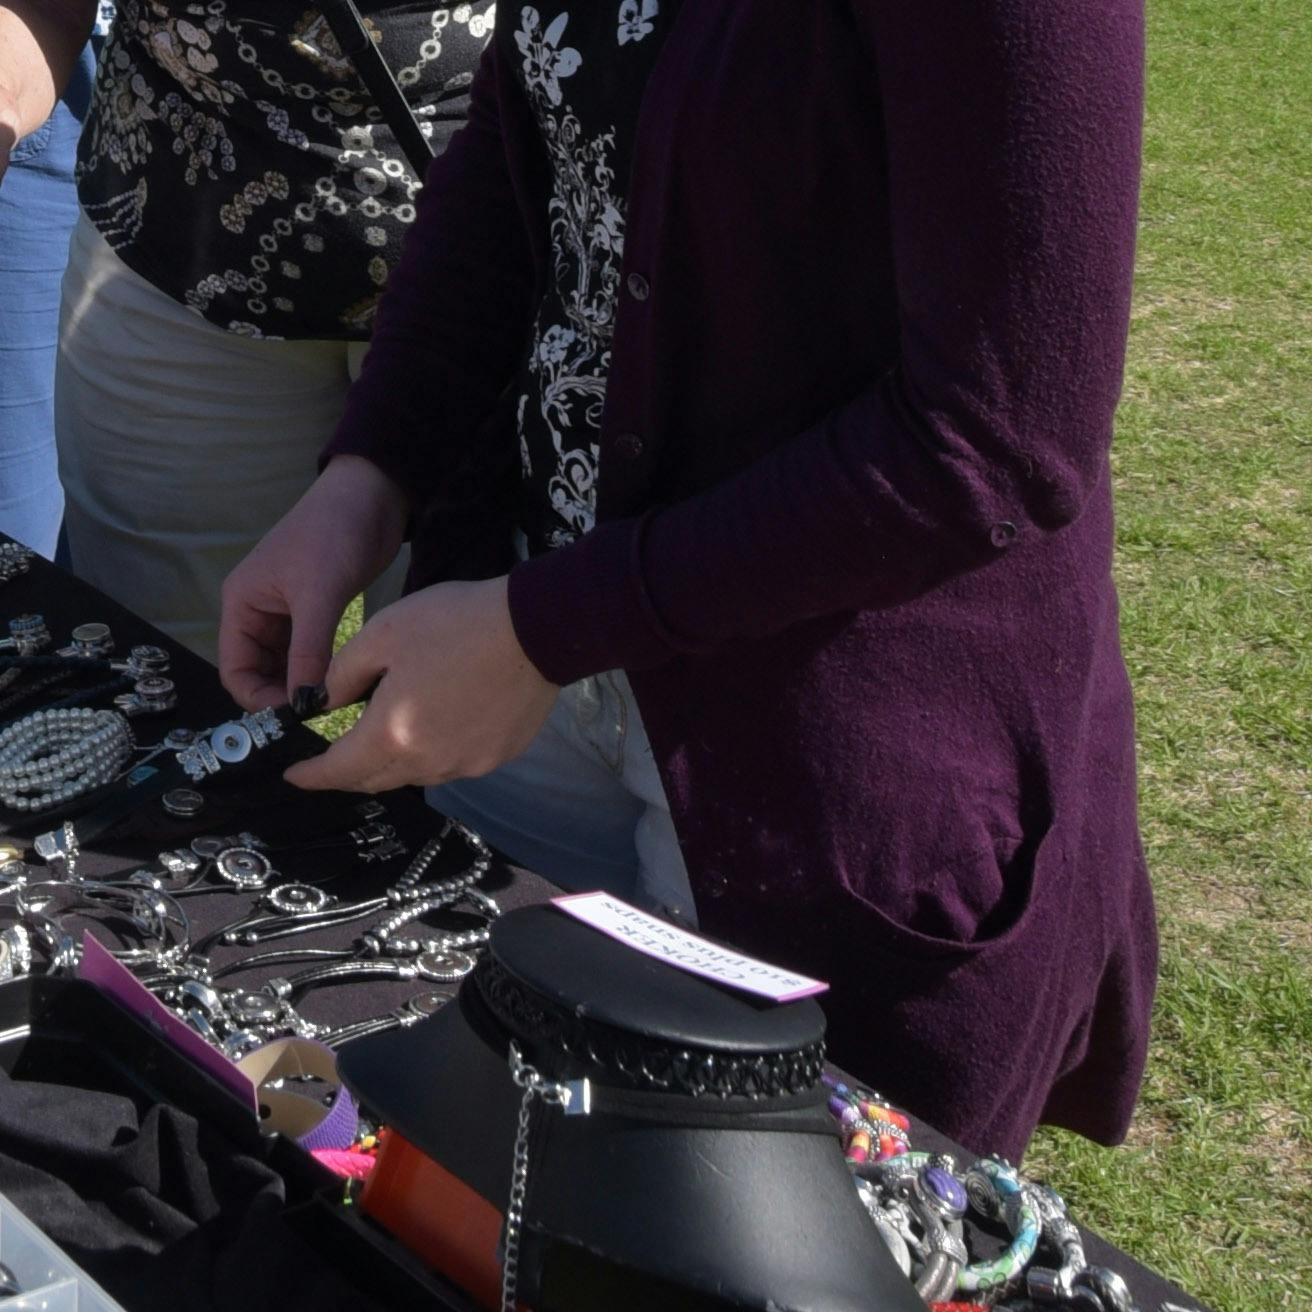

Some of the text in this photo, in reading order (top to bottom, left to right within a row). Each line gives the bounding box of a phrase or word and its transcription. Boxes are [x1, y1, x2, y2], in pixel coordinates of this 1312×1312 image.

[601, 901, 803, 987] $10 plus snaps
[616, 924, 745, 979] CHOKER
